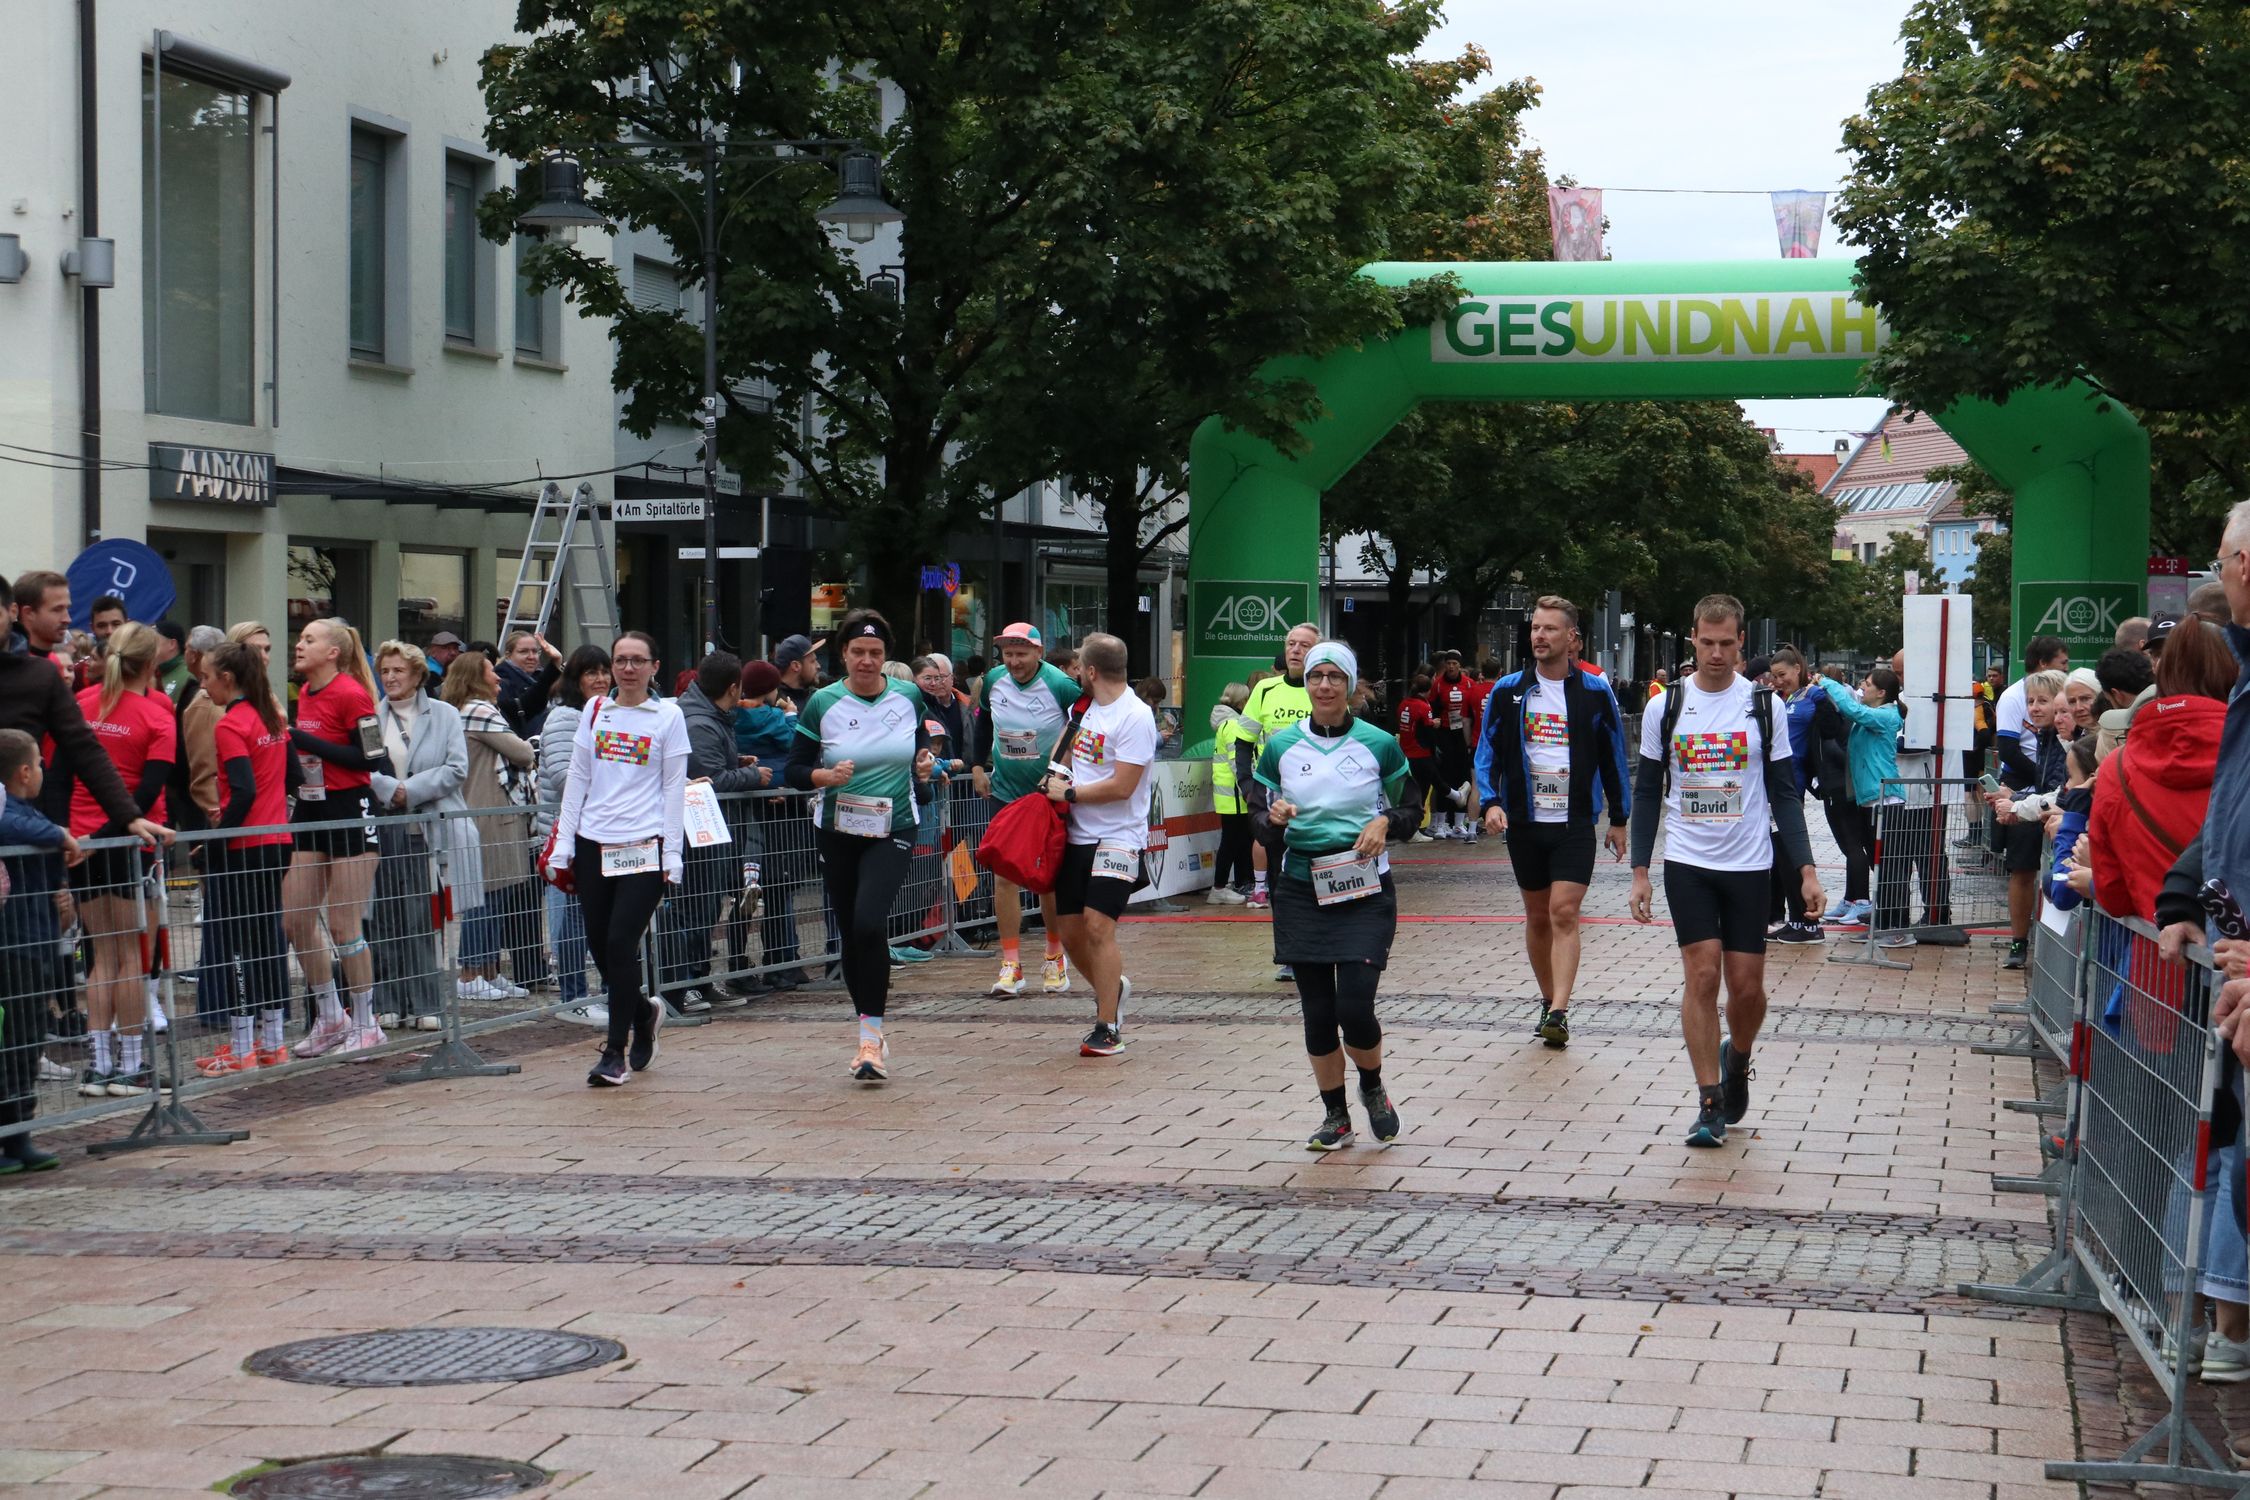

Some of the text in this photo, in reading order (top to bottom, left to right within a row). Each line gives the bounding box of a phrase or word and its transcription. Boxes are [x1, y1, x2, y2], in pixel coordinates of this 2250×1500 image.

[1445, 298, 1877, 357] GESUNDNAH
[624, 502, 701, 518] Am Spitaltörle
[1207, 594, 1292, 632] AOK
[2033, 596, 2122, 633] AOK
[1205, 632, 1287, 642] Die Gesundheitskass
[1006, 744, 1027, 754] Timo
[1536, 782, 1558, 794] Falk
[1681, 791, 1699, 799] 1698
[837, 804, 854, 814] 1474
[1691, 801, 1728, 814] David
[613, 856, 646, 869] Sonja
[1103, 858, 1128, 872] Sven
[1314, 870, 1334, 881] 1482
[1327, 876, 1365, 894] Karin
